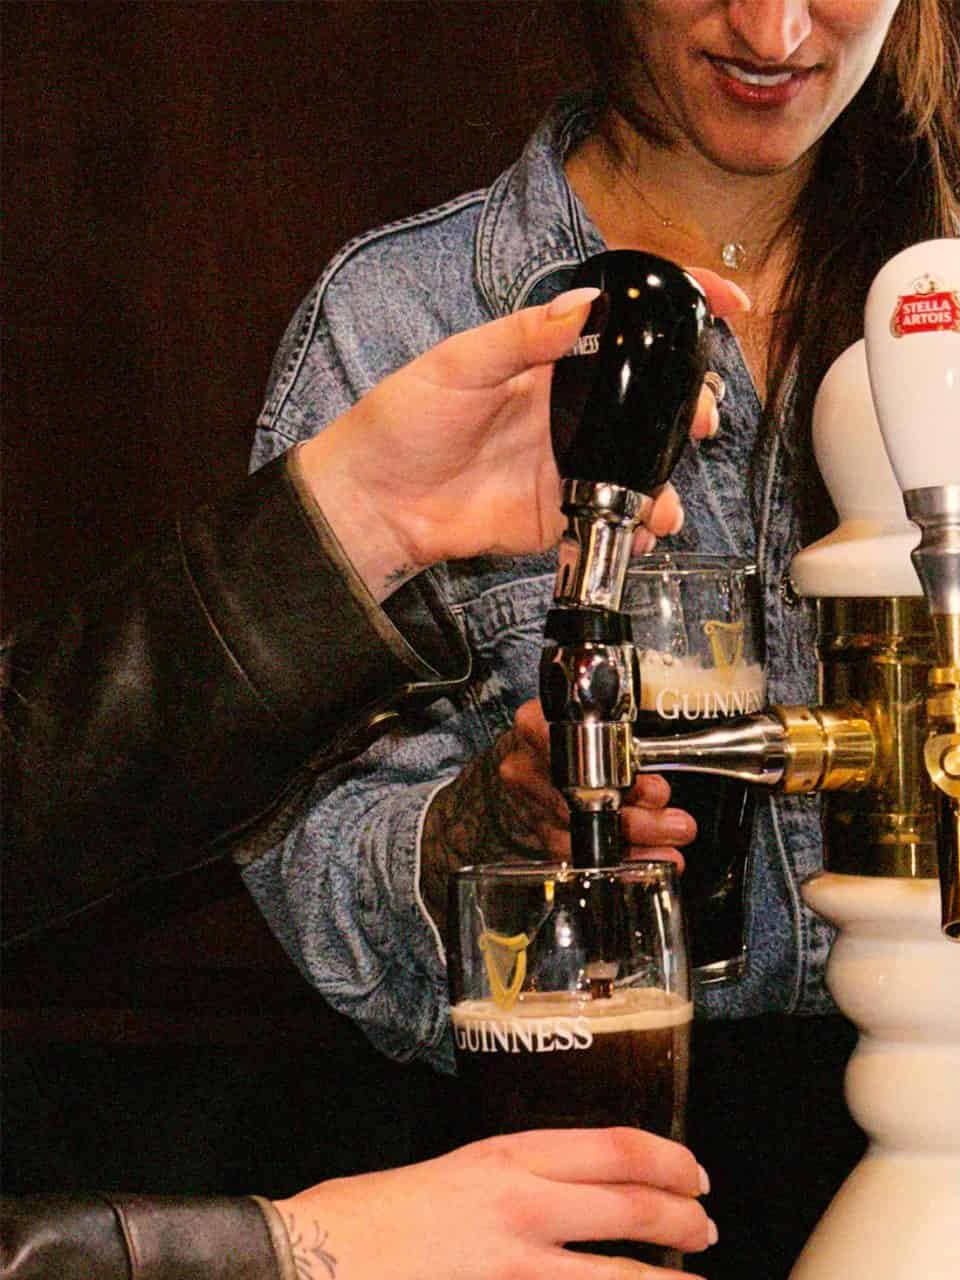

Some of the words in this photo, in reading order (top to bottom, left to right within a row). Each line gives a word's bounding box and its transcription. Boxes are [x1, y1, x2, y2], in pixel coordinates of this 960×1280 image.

[903, 299, 953, 314] STELLA
[903, 311, 953, 326] ARTOIS
[454, 1015, 594, 1053] GUINNESS
